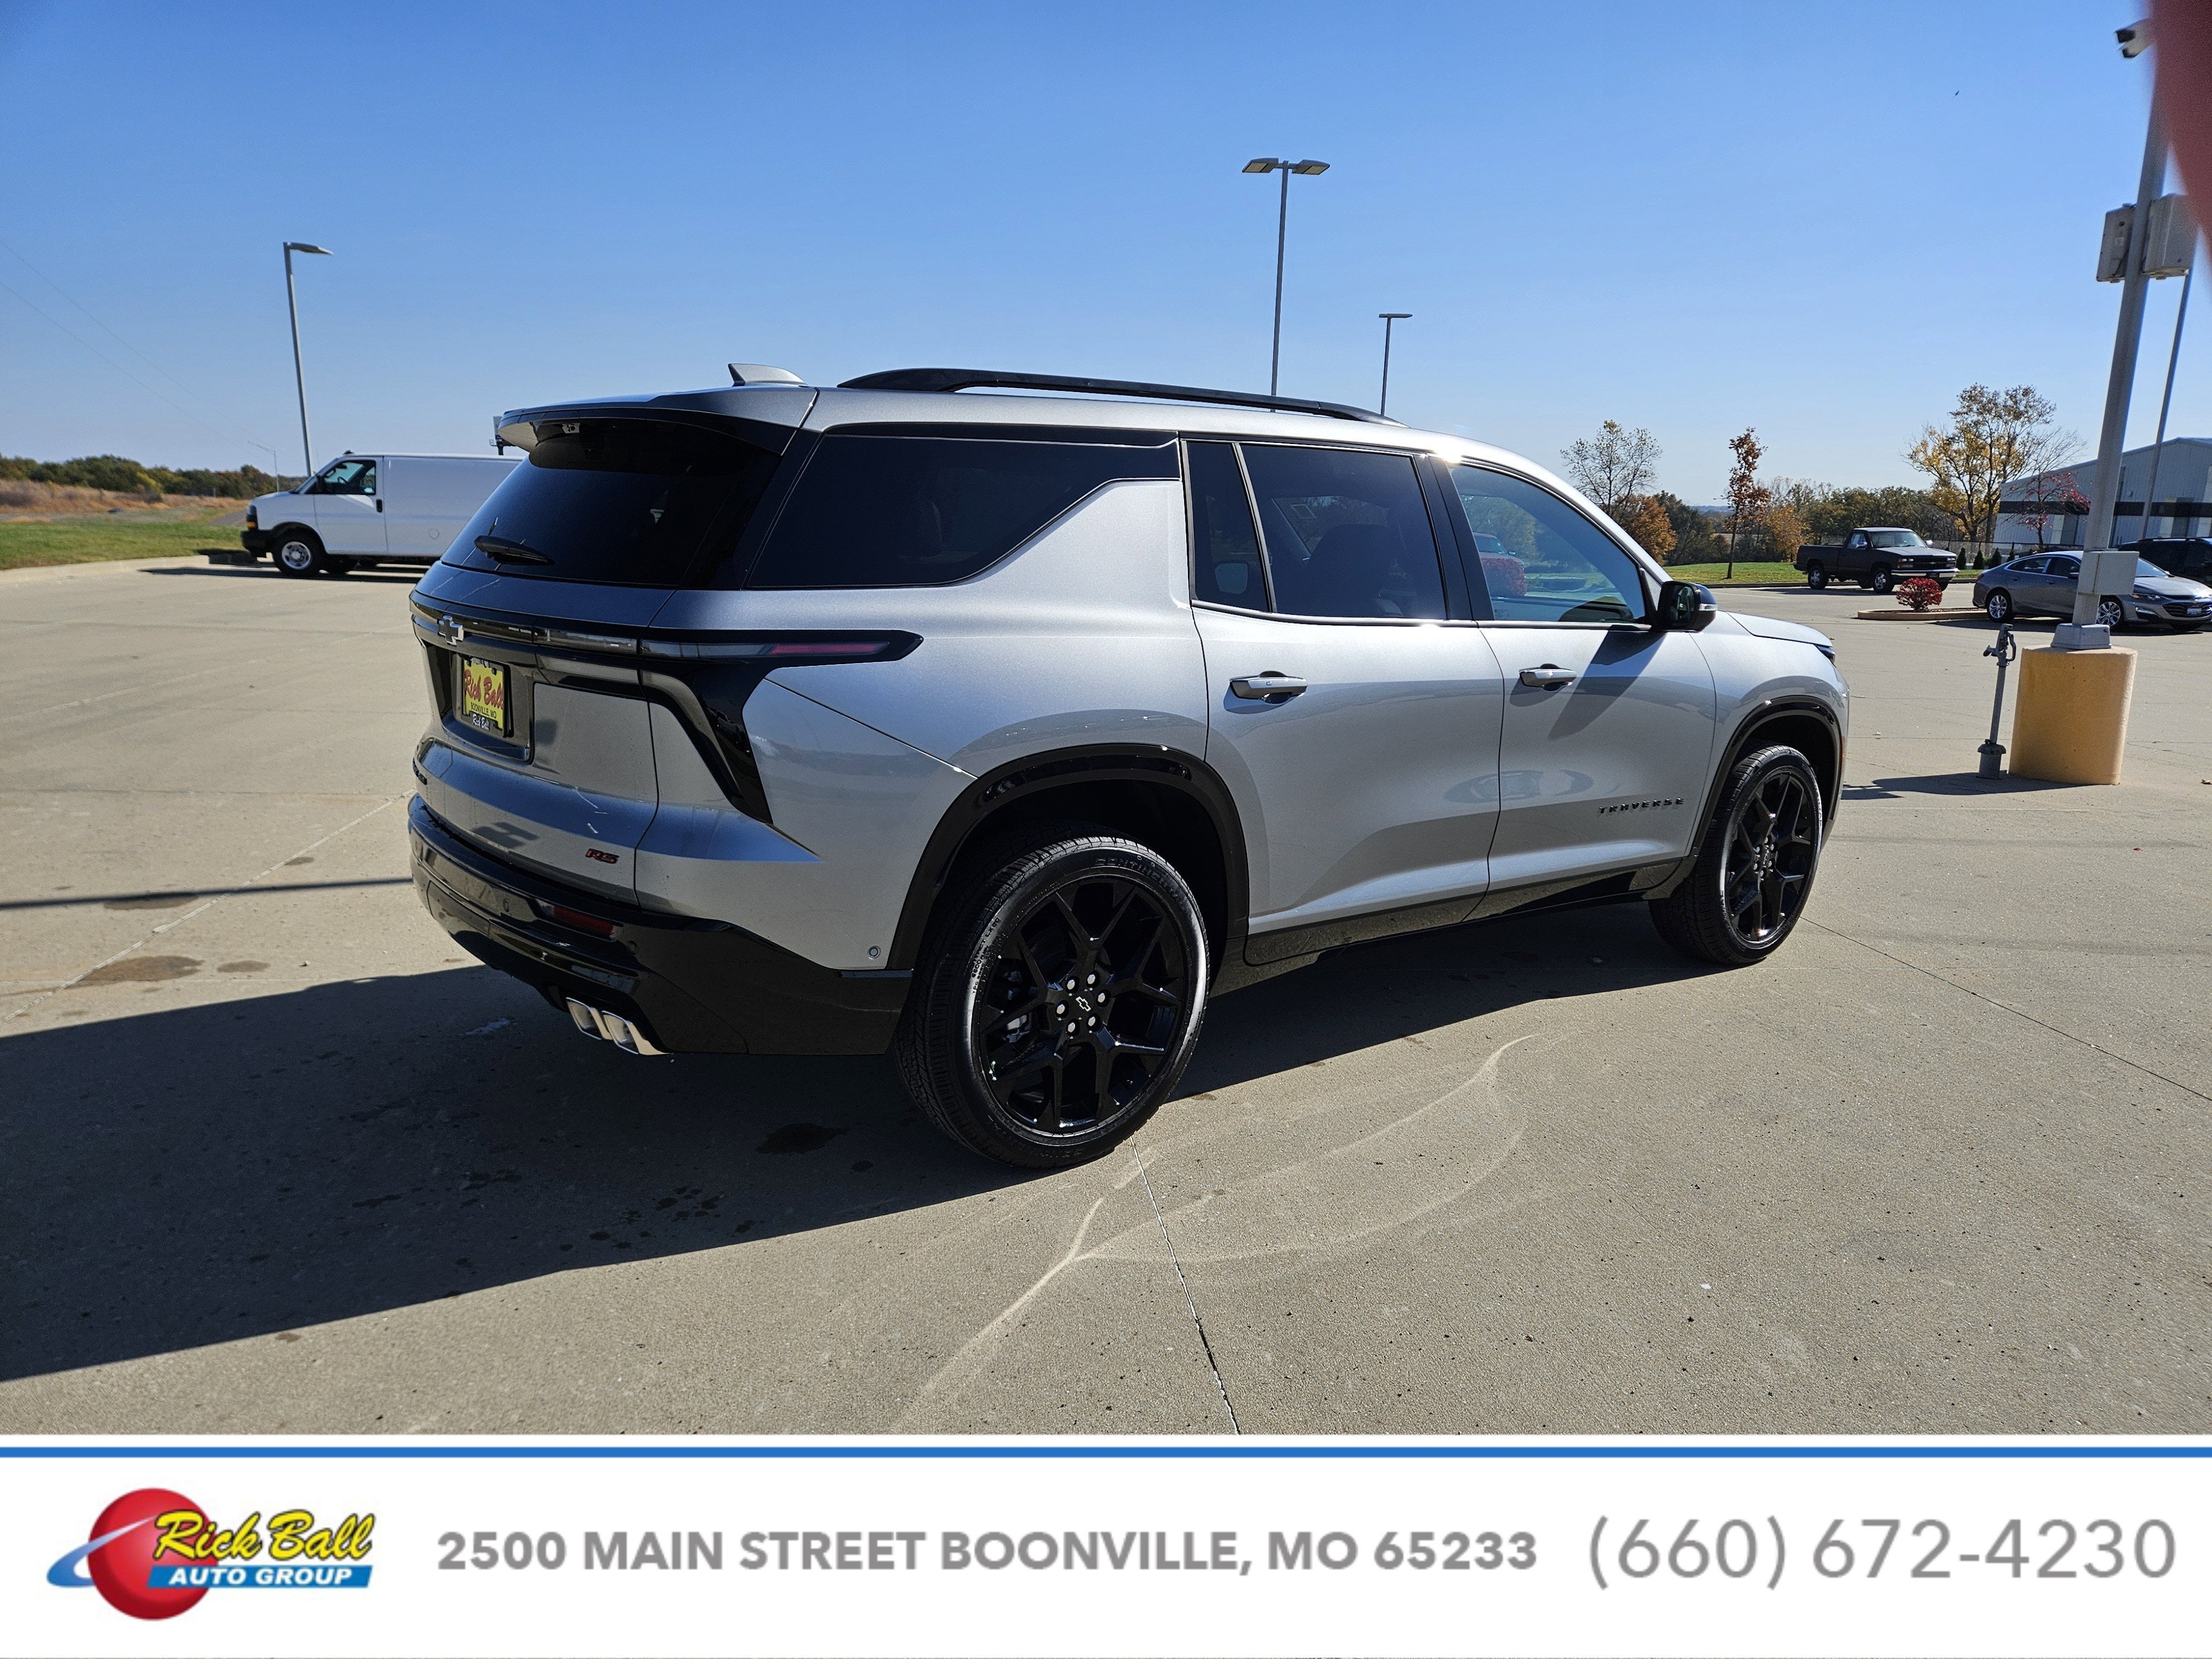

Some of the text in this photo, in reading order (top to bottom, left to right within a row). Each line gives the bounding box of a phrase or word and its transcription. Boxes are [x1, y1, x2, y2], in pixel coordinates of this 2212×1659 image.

[464, 669, 482, 702] Rick
[490, 709, 497, 719] MO
[1598, 797, 1685, 813] TRAVERSE
[585, 848, 619, 864] RS
